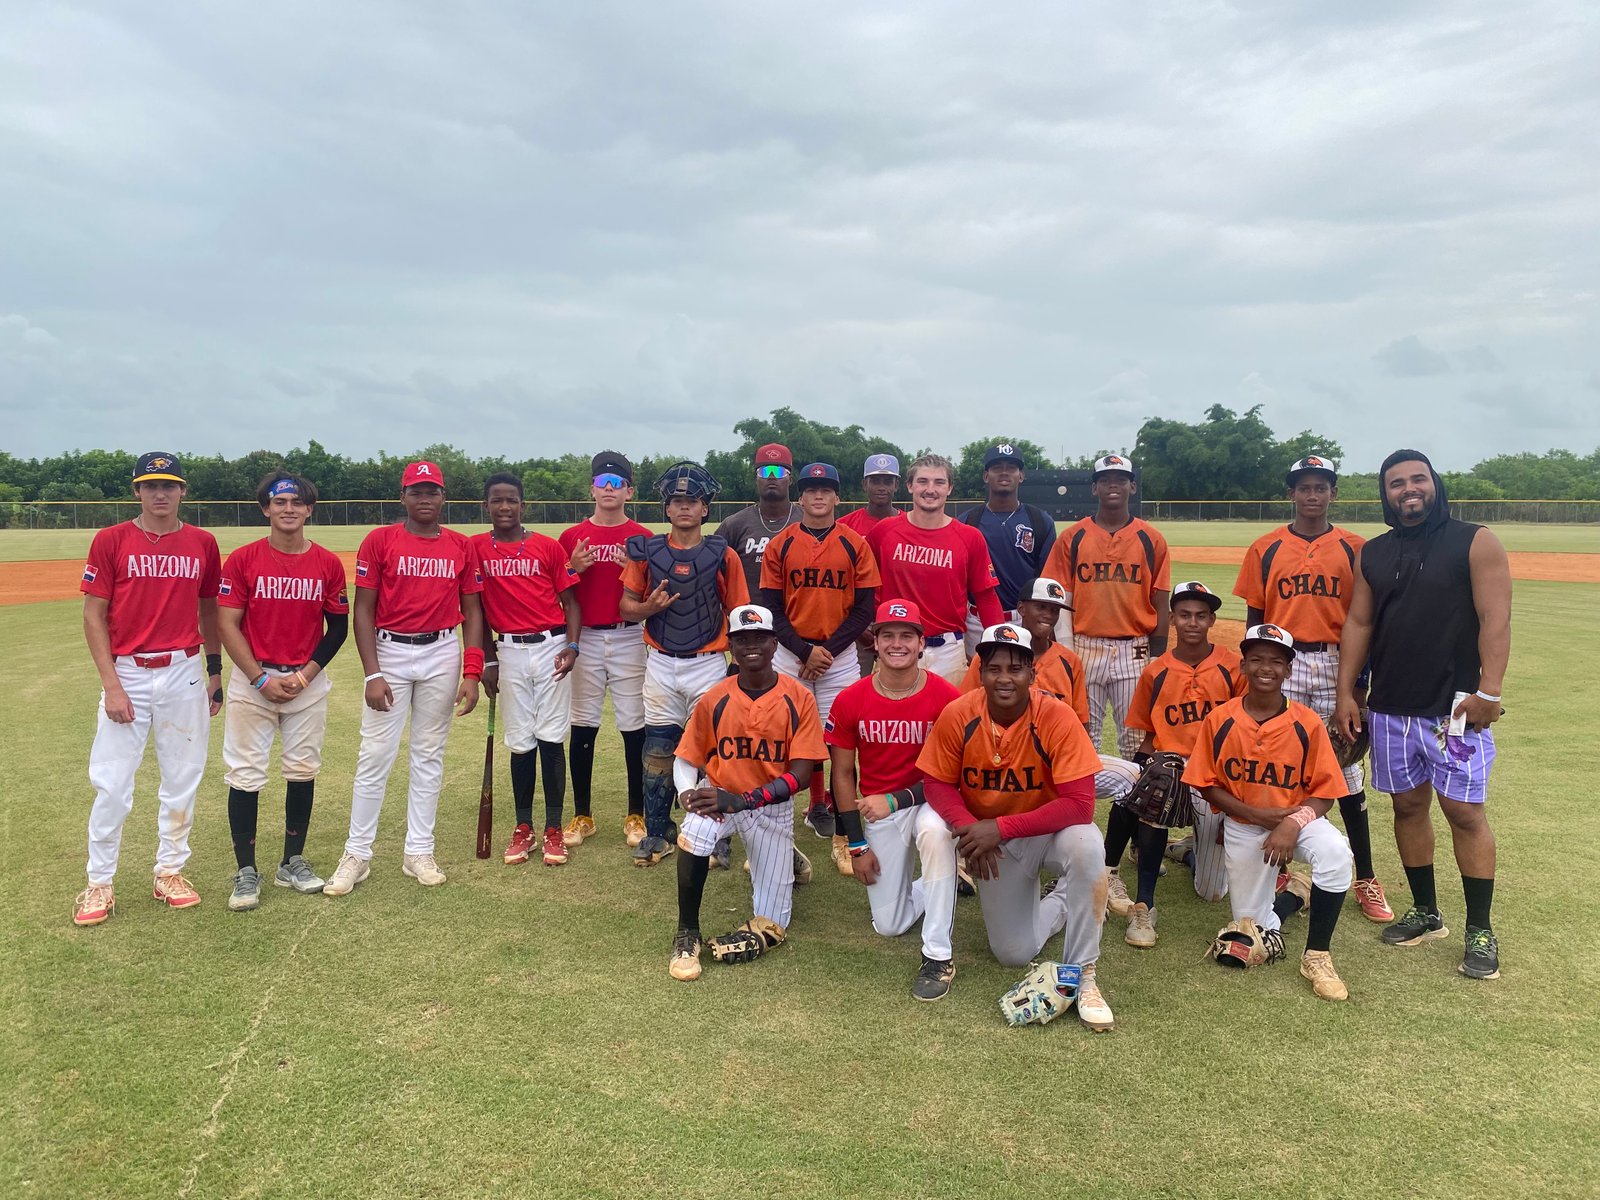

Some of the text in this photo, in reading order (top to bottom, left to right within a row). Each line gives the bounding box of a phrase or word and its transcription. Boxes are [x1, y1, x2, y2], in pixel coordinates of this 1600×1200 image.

[417, 465, 431, 475] A
[745, 536, 770, 554] D-B
[892, 543, 953, 569] ARIZONA
[128, 555, 200, 579] ARIZONA
[396, 556, 456, 579] ARIZONA
[483, 558, 540, 577] ARIZONA
[790, 567, 848, 591] CHAL
[1077, 562, 1142, 585] CHAL
[255, 576, 323, 602] ARIZONA
[1278, 574, 1341, 600] CHAL
[1164, 700, 1227, 726] CHA
[718, 737, 785, 763] CHAL
[962, 766, 1043, 793] CHAL
[1225, 757, 1298, 790] CHAL
